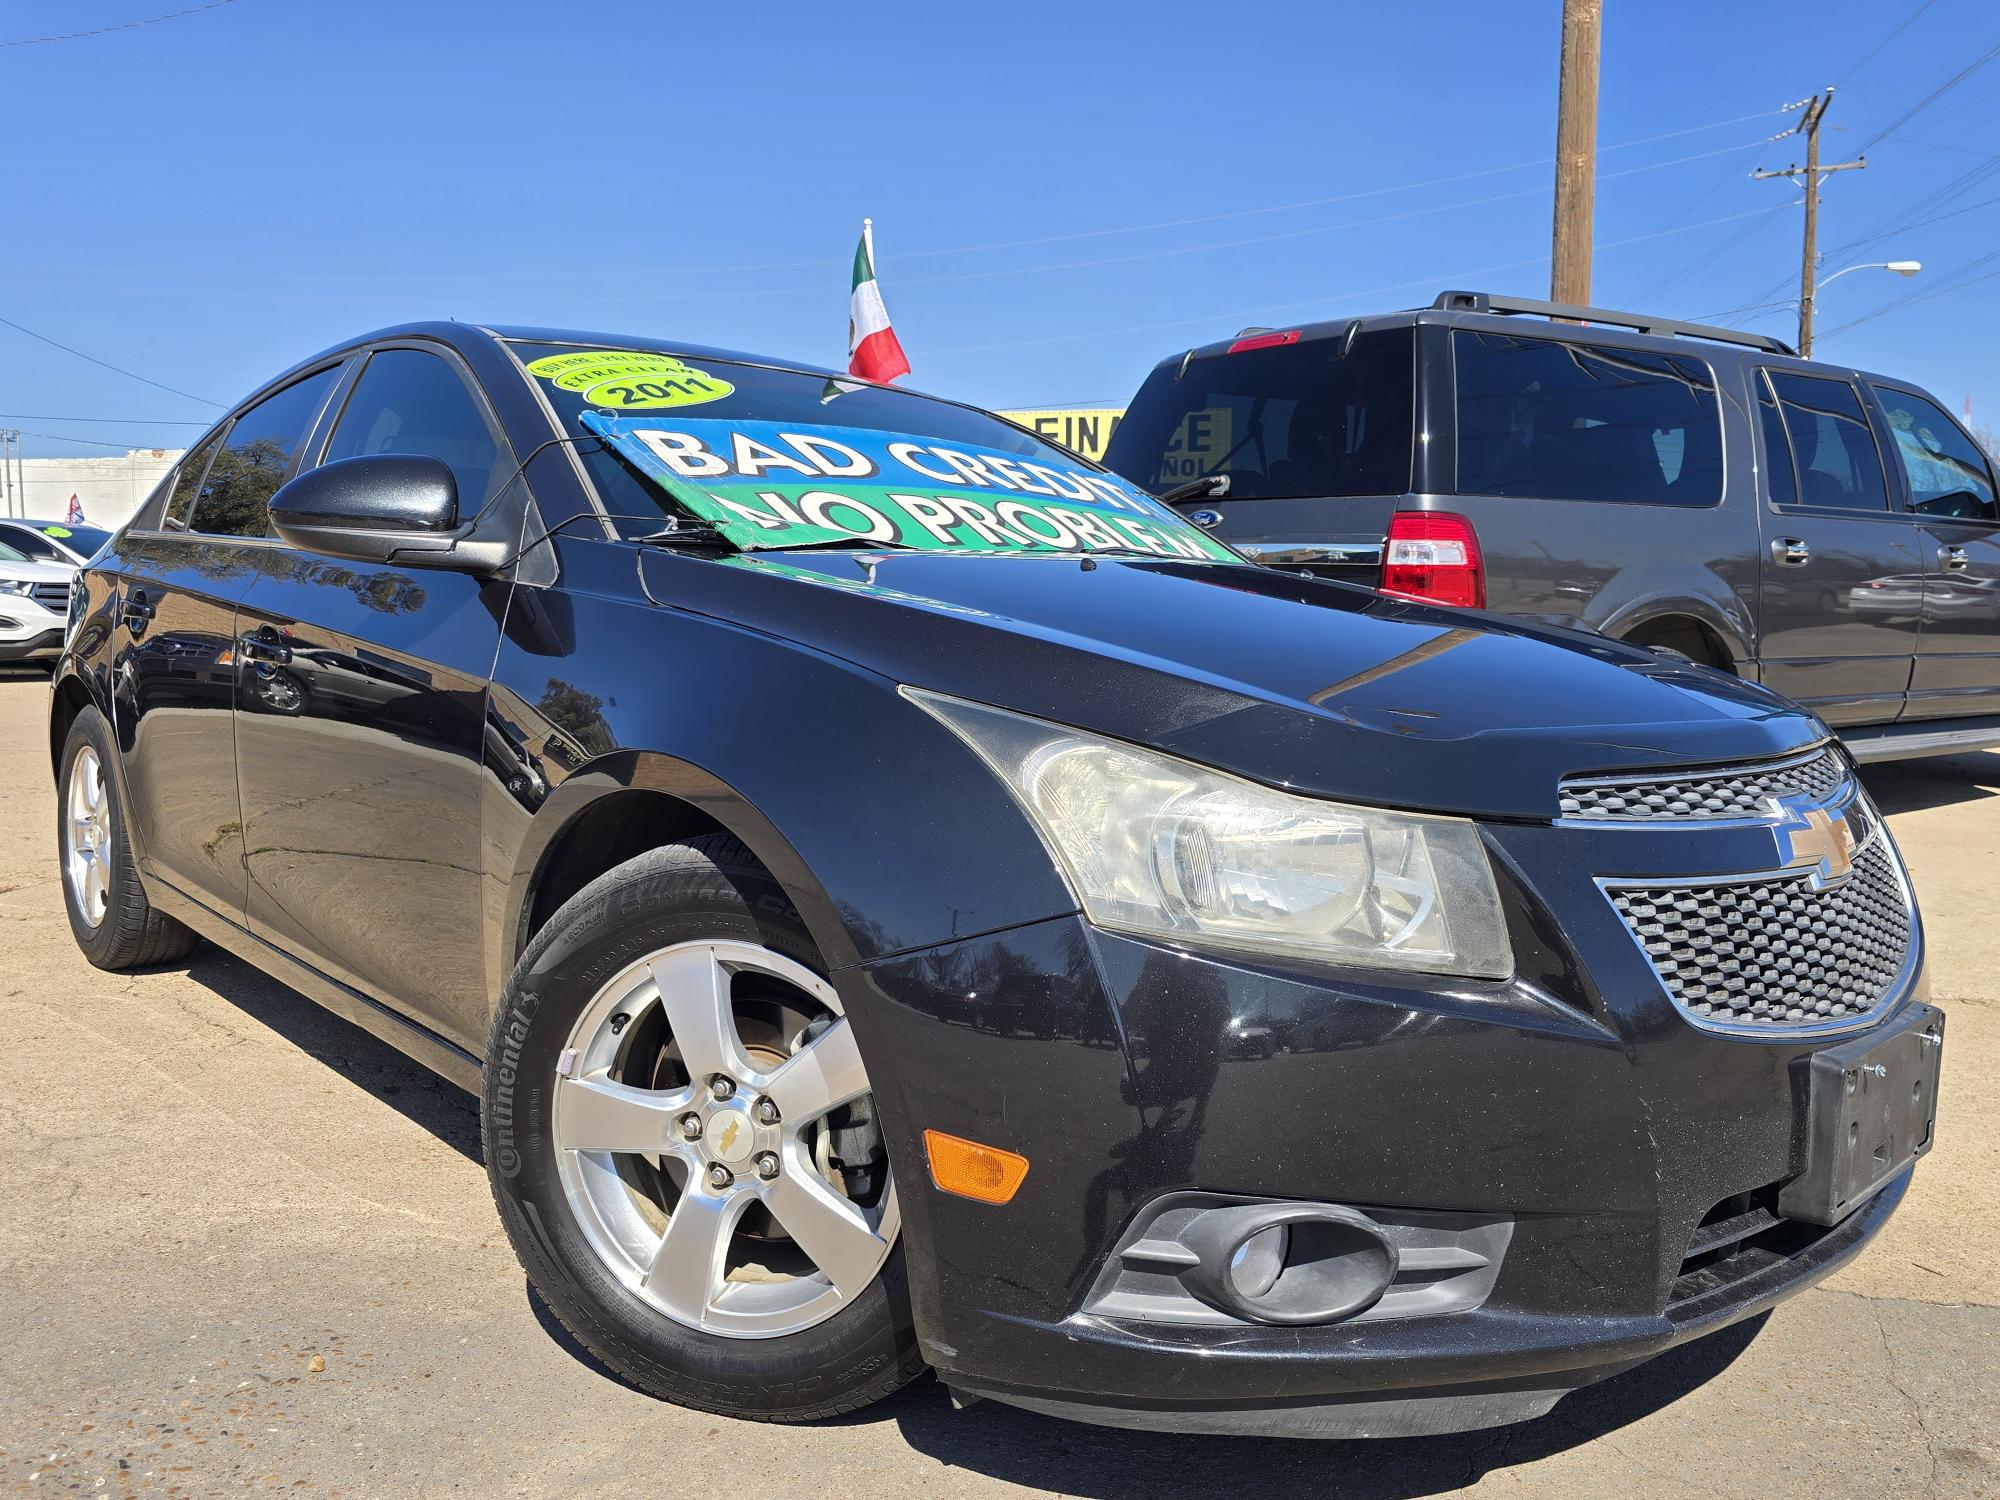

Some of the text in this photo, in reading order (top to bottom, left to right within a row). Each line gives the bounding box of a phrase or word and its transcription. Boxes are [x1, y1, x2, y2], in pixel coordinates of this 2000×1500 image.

[564, 366, 694, 388] EXTRA CLEAN
[607, 378, 715, 405] 2011
[630, 429, 1152, 516] BAD CREDIT
[707, 490, 1217, 562] NO PROBLEM
[494, 1007, 533, 1179] Continental
